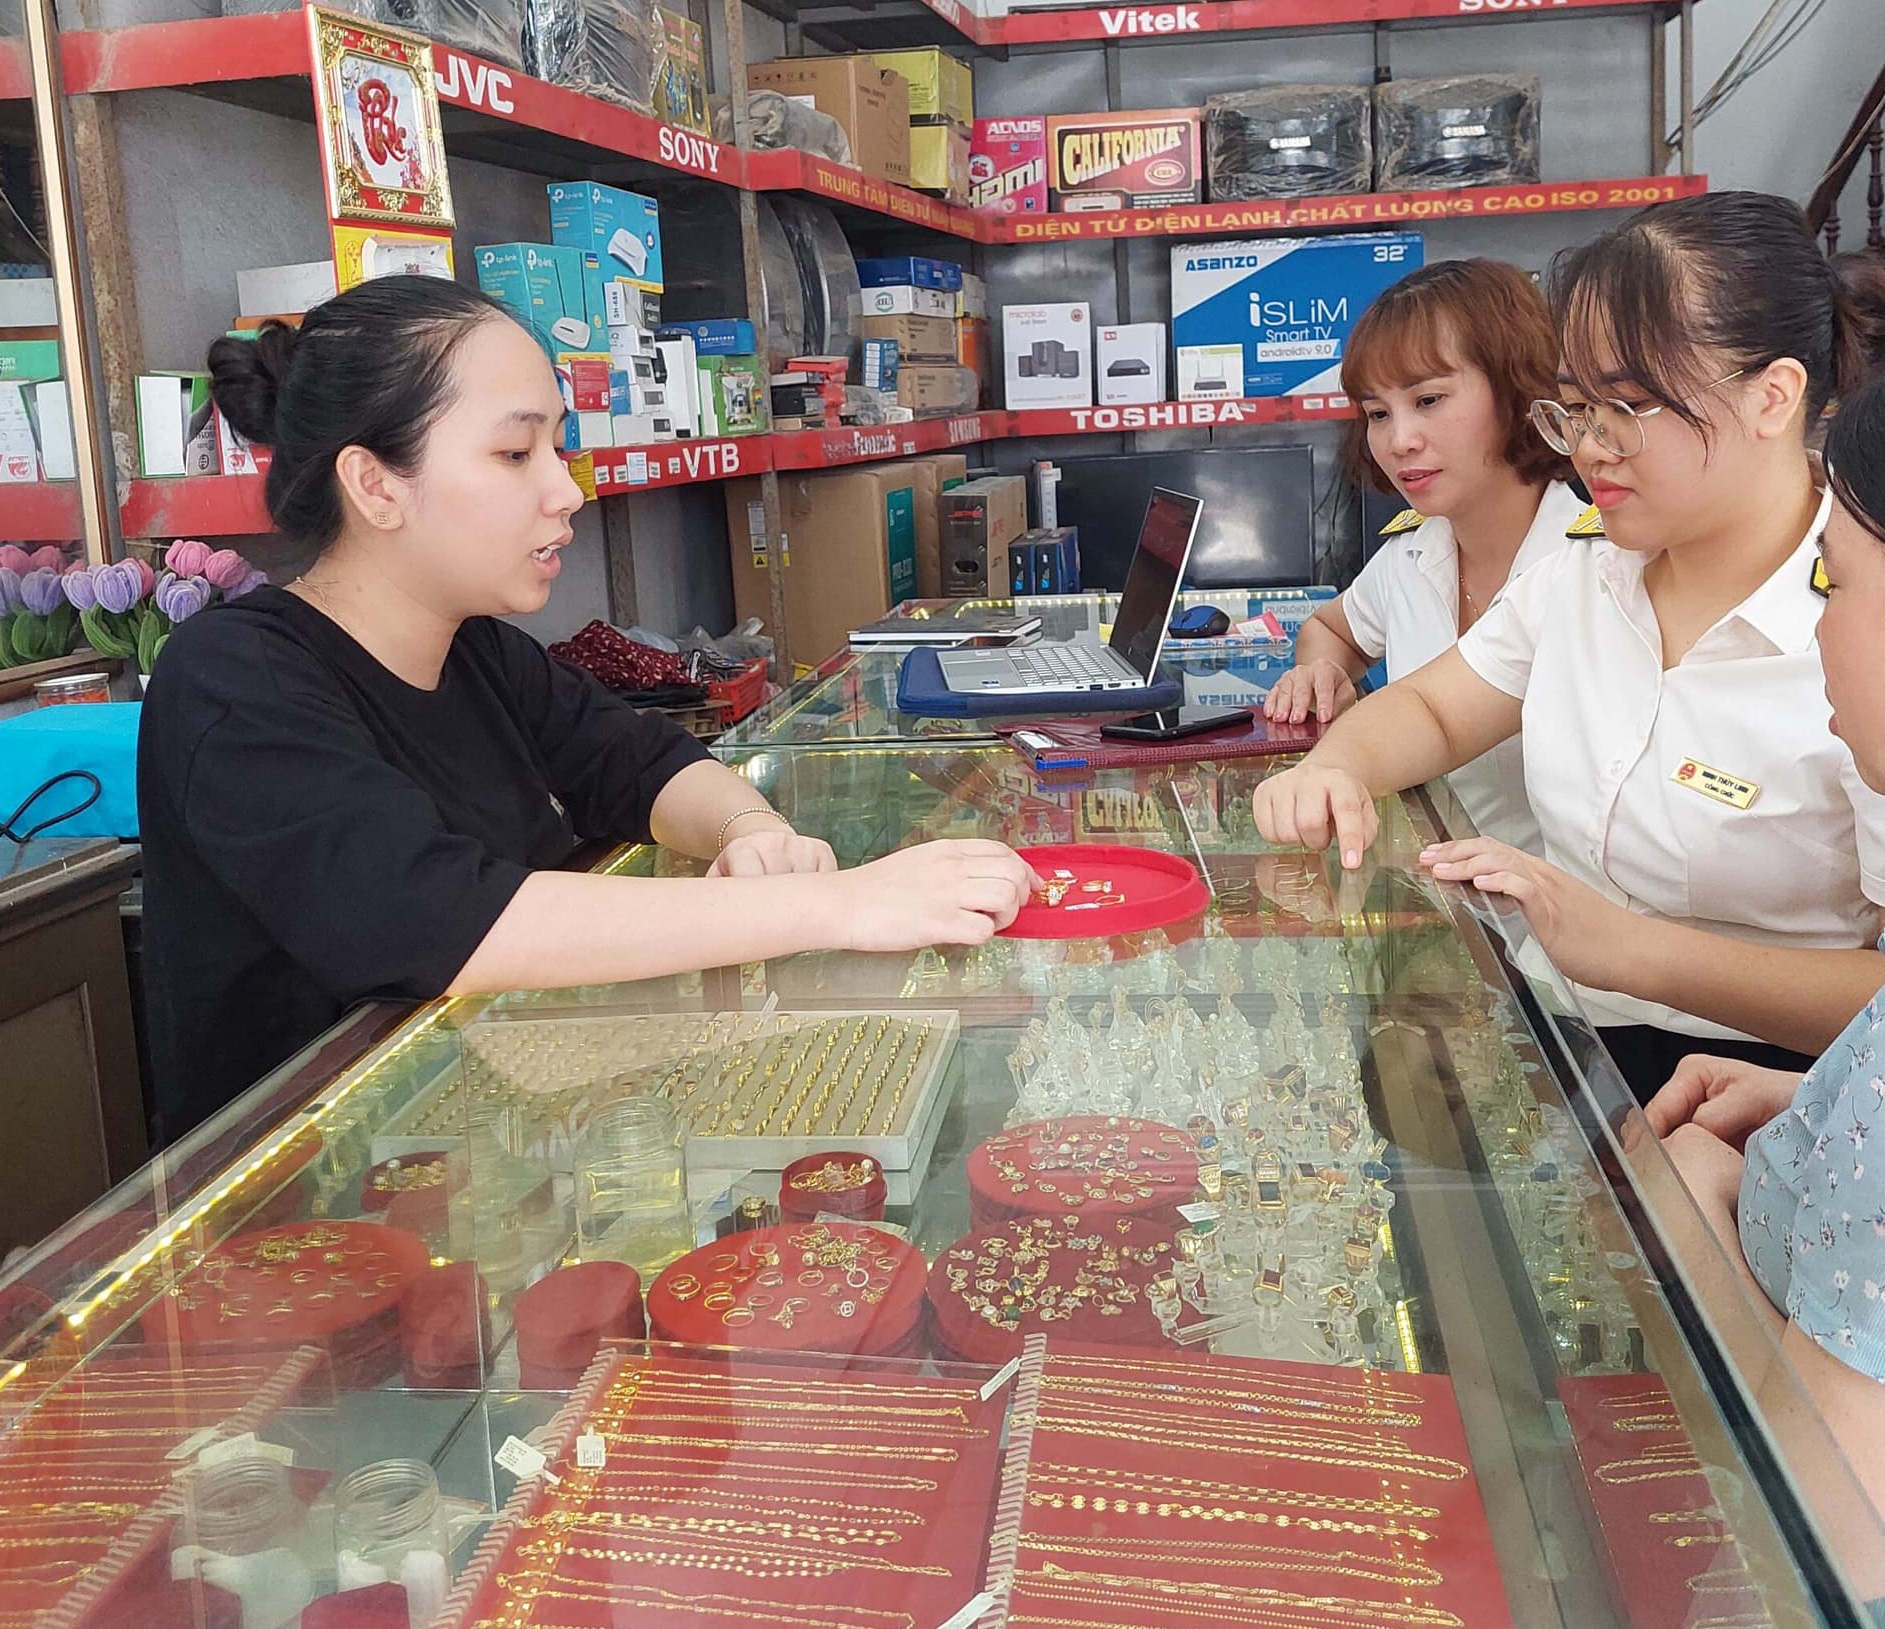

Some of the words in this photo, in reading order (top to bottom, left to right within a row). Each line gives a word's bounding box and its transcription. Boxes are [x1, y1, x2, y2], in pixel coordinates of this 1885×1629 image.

[1099, 6, 1200, 35] Vitek
[435, 54, 514, 114] JVC
[658, 126, 720, 173] SONY
[1062, 126, 1183, 186] CALIFORNIA
[816, 169, 861, 199] TRUNG
[1015, 216, 1081, 239] ĐIỆN
[1089, 213, 1129, 233] TỬ
[1134, 213, 1200, 235] ĐIỆN
[1374, 197, 1474, 219] LƯỢNG
[1483, 193, 1545, 211] CAO
[1550, 190, 1599, 207] ISO
[1609, 186, 1676, 203] 2001
[1265, 328, 1311, 343] Smart
[1313, 326, 1332, 340] TV
[1315, 343, 1332, 356] 9.0
[1071, 403, 1245, 429] TOSHIBA
[682, 443, 740, 478] VTB
